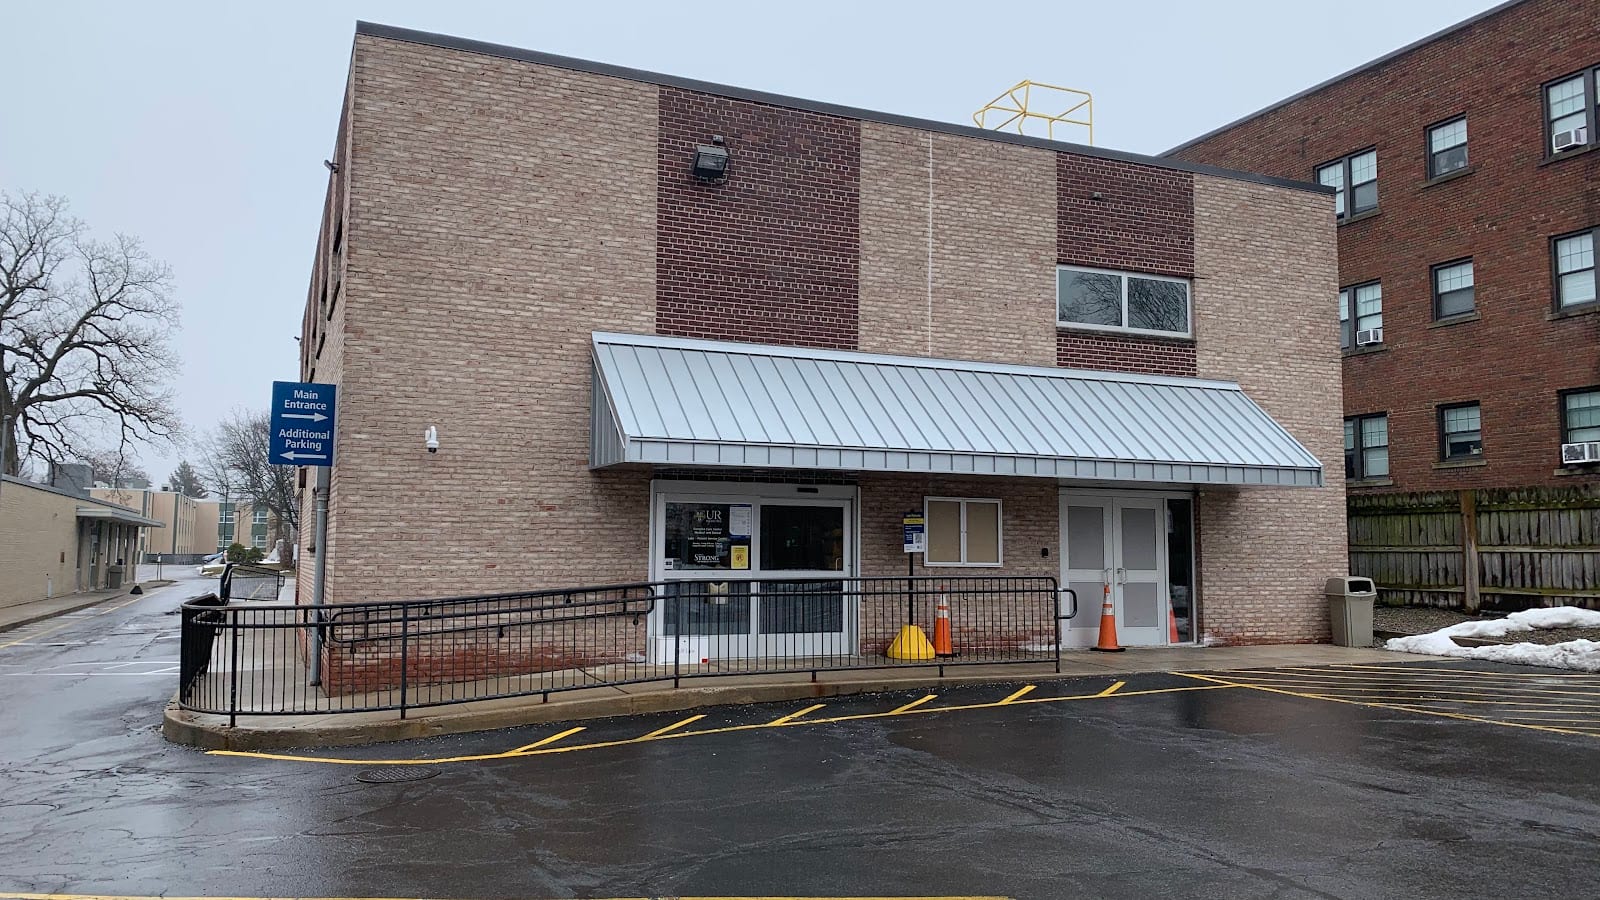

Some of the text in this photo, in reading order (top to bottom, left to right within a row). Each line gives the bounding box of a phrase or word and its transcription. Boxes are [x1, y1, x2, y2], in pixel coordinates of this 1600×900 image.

[294, 390, 318, 399] Main
[284, 400, 327, 410] Entrance
[279, 429, 330, 439] Additional
[285, 439, 322, 451] Parking
[706, 510, 722, 520] UR
